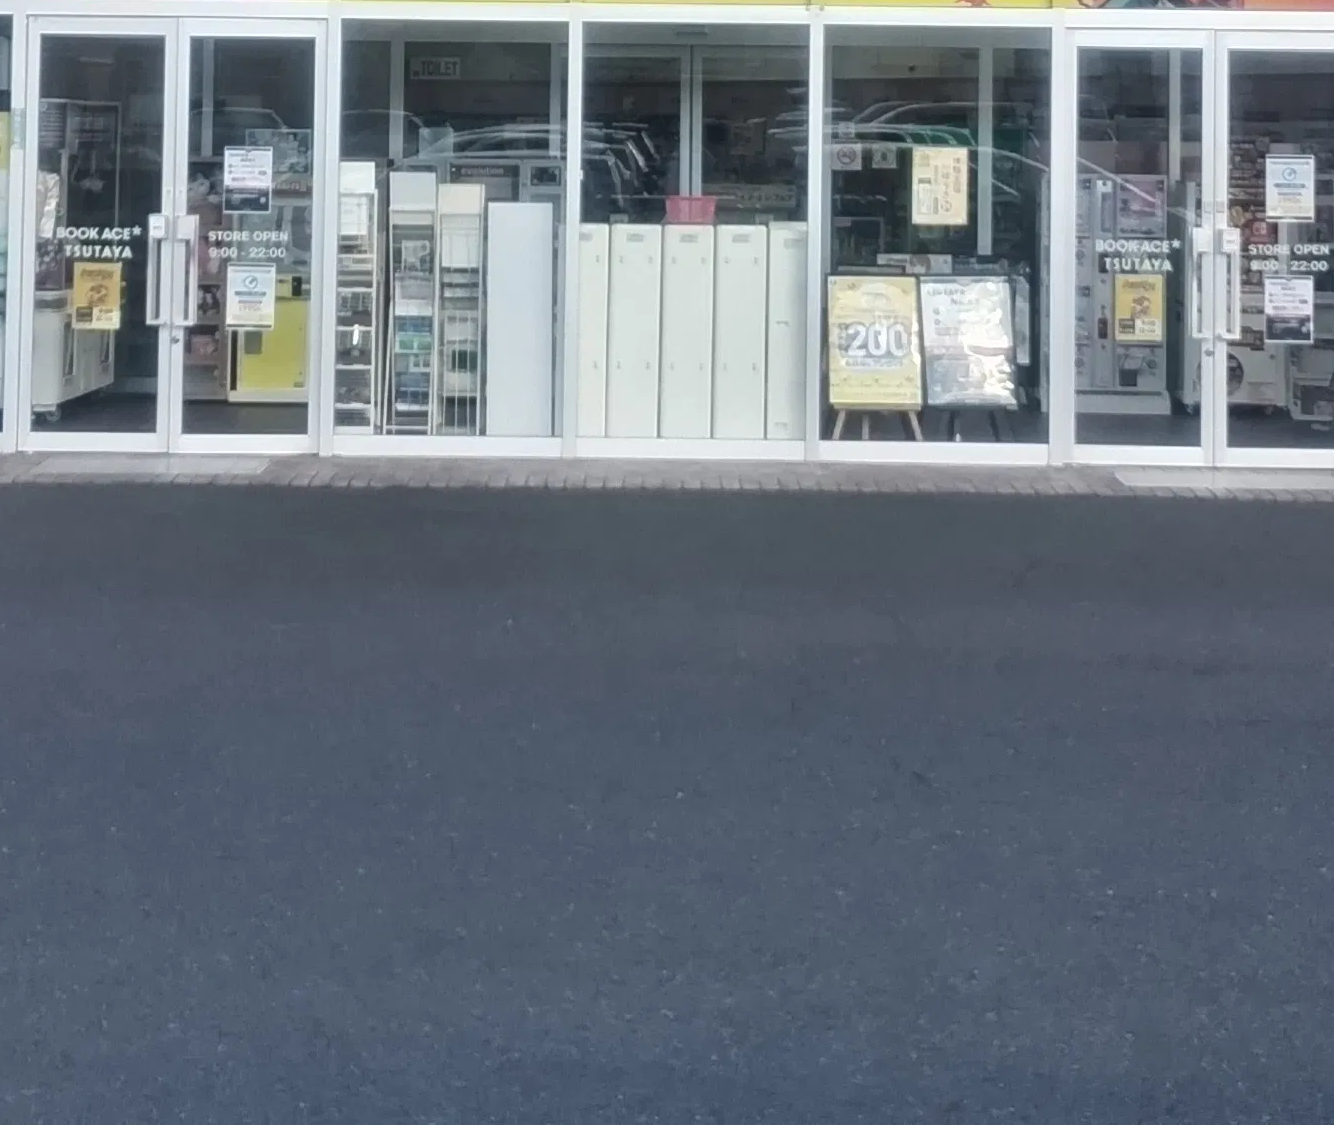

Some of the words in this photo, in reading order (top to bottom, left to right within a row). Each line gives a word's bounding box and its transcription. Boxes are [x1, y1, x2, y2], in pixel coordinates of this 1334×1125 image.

[56, 226, 99, 239] BOOK
[208, 231, 249, 241] STORE
[253, 231, 288, 241] OPEN
[64, 245, 133, 258] TSUTAYA
[1095, 239, 1139, 252] BOOK
[1248, 244, 1290, 255] STORE
[1293, 244, 1330, 255] OPEN
[249, 247, 286, 258] 22:00
[1104, 257, 1174, 272] TSUTAYA
[1291, 260, 1329, 271] 22:00
